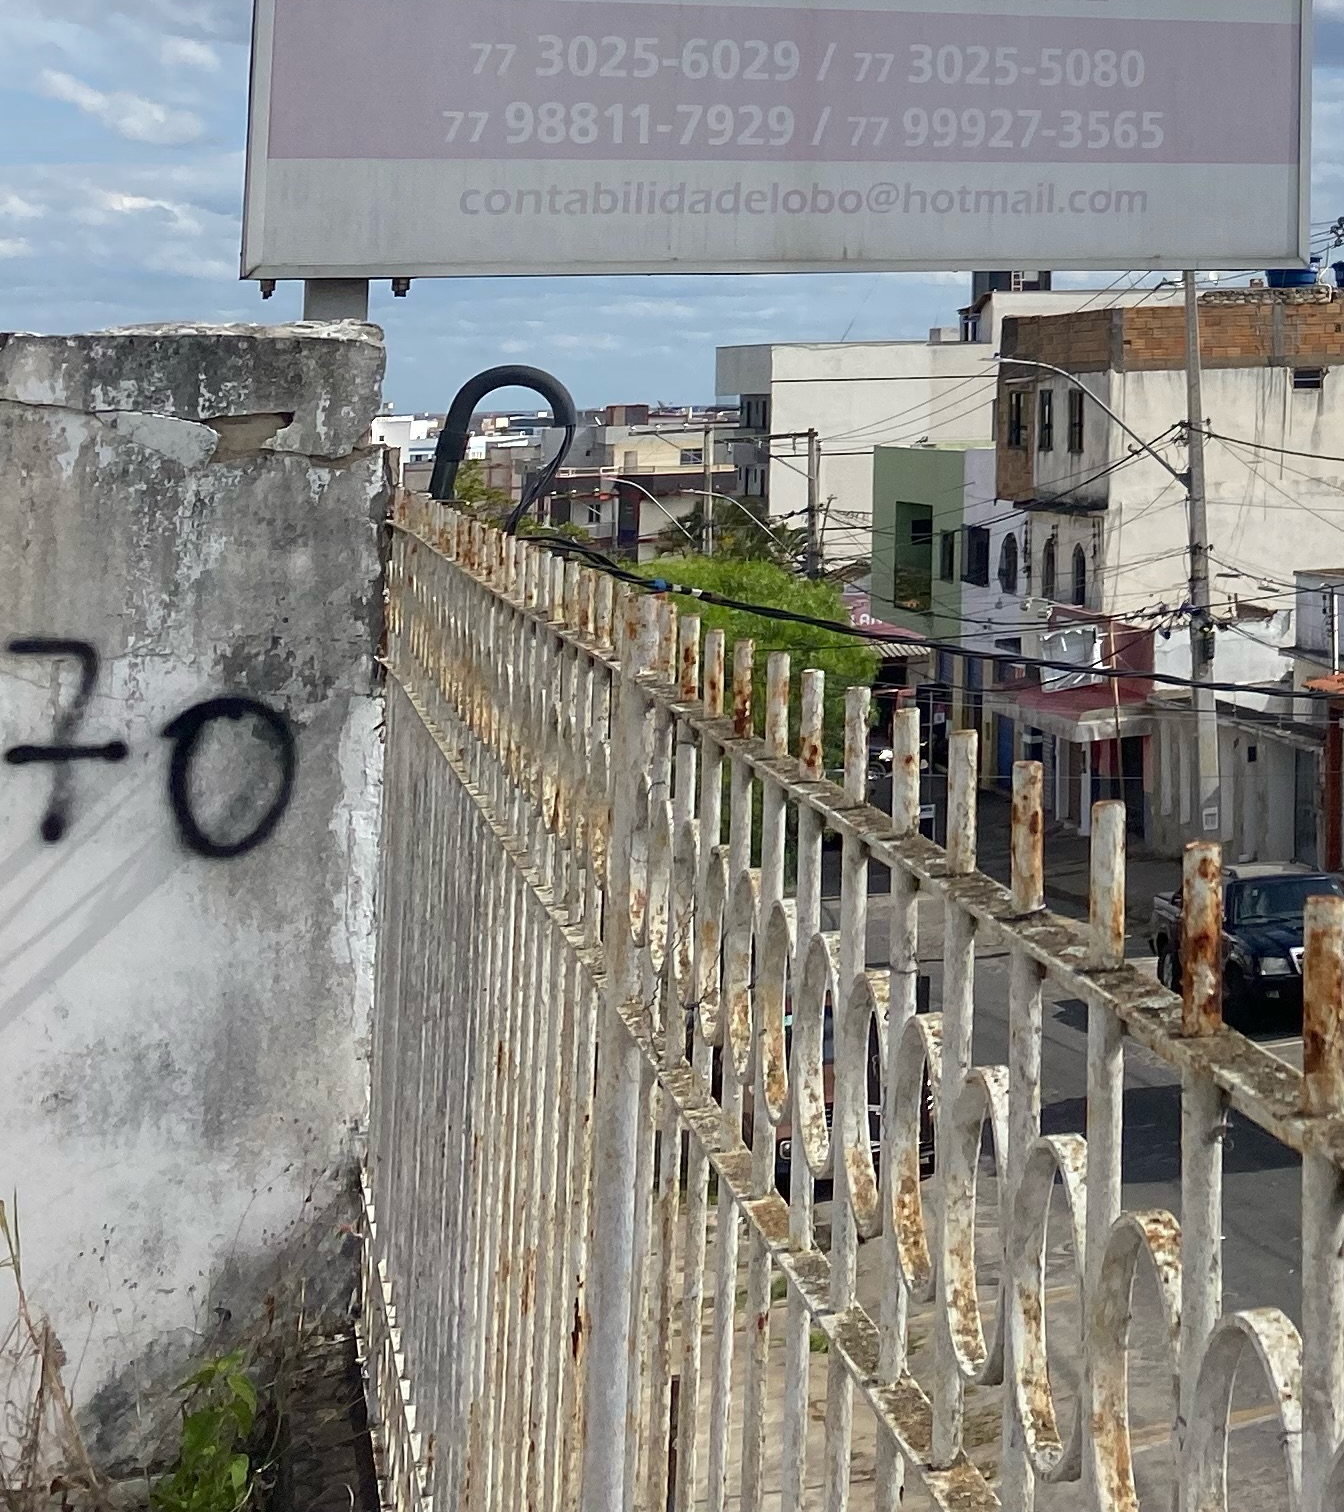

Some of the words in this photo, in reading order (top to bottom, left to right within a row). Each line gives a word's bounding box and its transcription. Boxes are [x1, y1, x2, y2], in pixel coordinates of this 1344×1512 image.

[469, 41, 517, 76] 77
[535, 33, 801, 82] 3025-6029
[817, 42, 836, 83] /
[852, 52, 895, 84] 77
[908, 42, 1146, 88] 3025-5080
[441, 109, 489, 144] 77
[504, 101, 796, 146] 98811-7929
[810, 106, 831, 149] /
[846, 115, 891, 147] 77
[902, 107, 1165, 151] 99927-3565
[458, 179, 1149, 217] contabilidadelobo@hotmail.com
